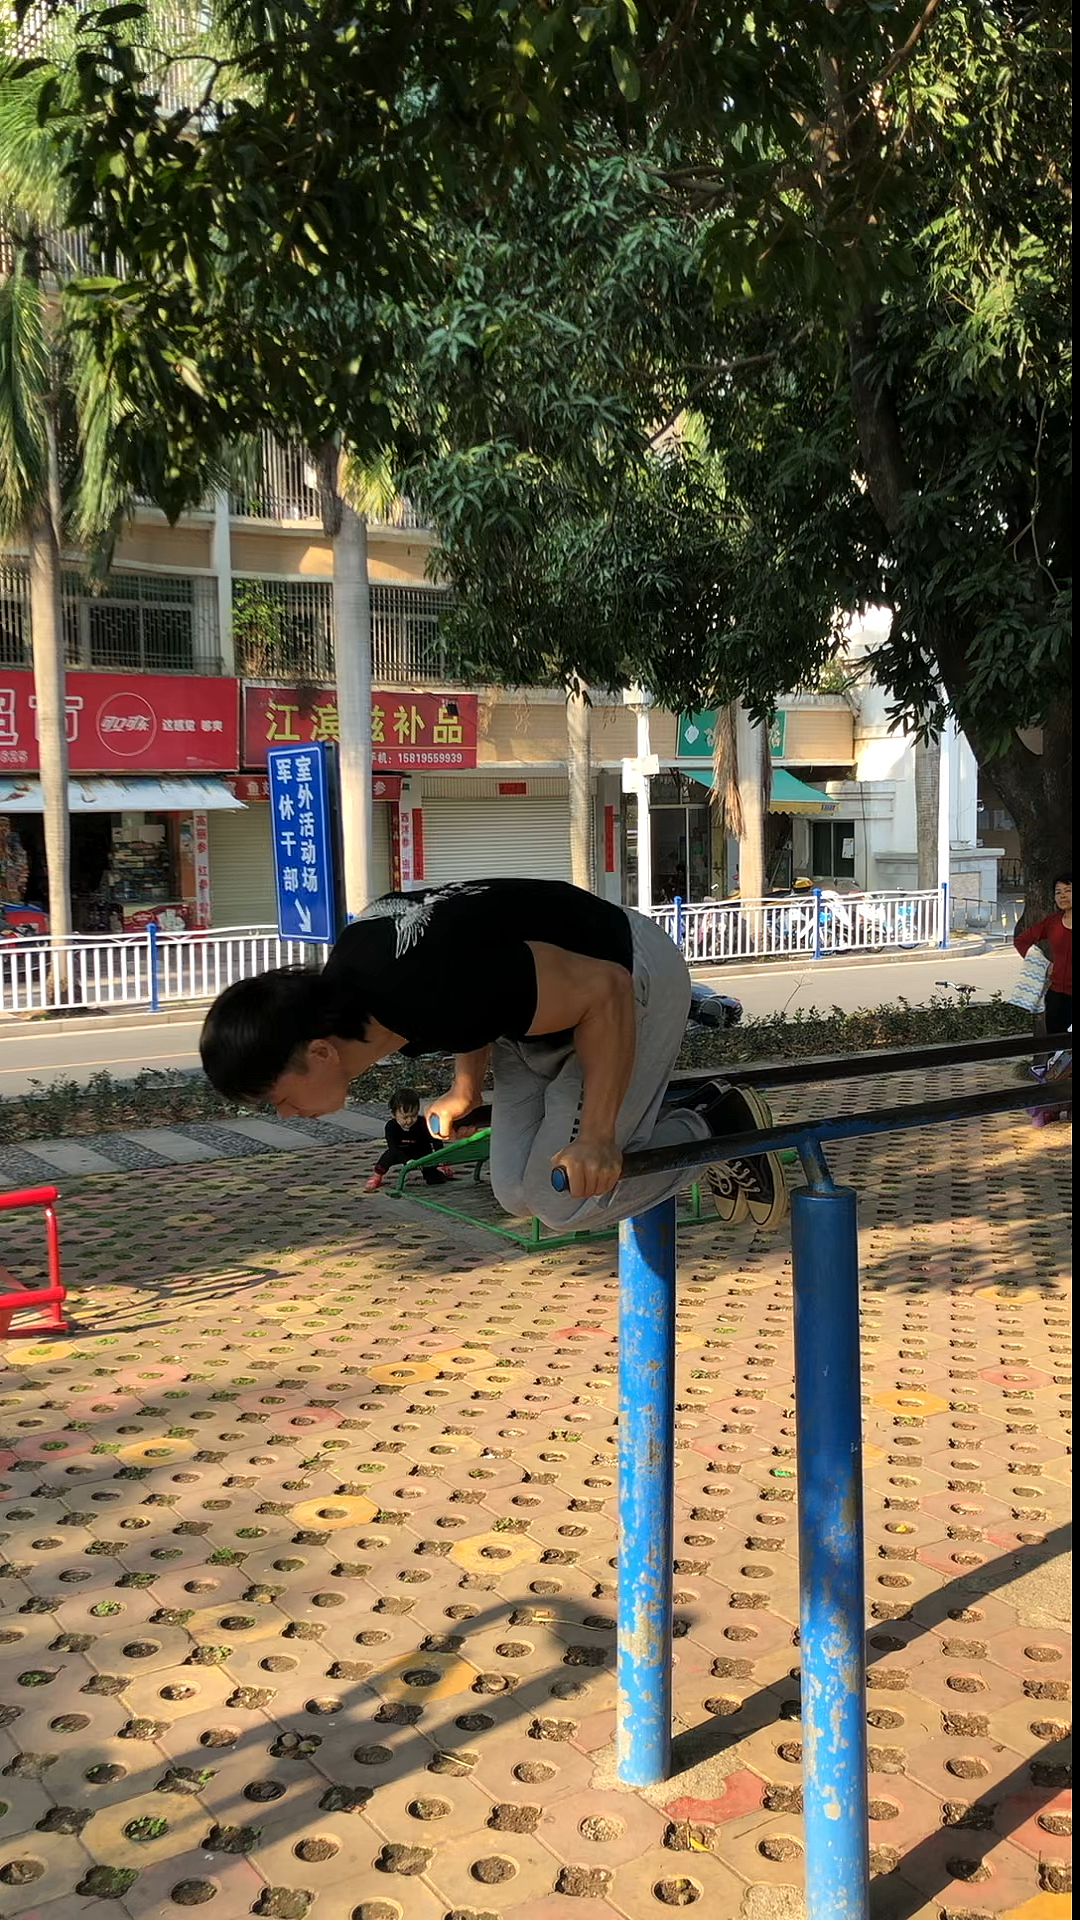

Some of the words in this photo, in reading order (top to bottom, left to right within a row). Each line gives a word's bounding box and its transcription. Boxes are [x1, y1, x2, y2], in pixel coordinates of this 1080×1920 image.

[275, 758, 299, 892] 军休干部
[295, 755, 318, 893] 室外活动场
[398, 753, 463, 763] 15819559939
